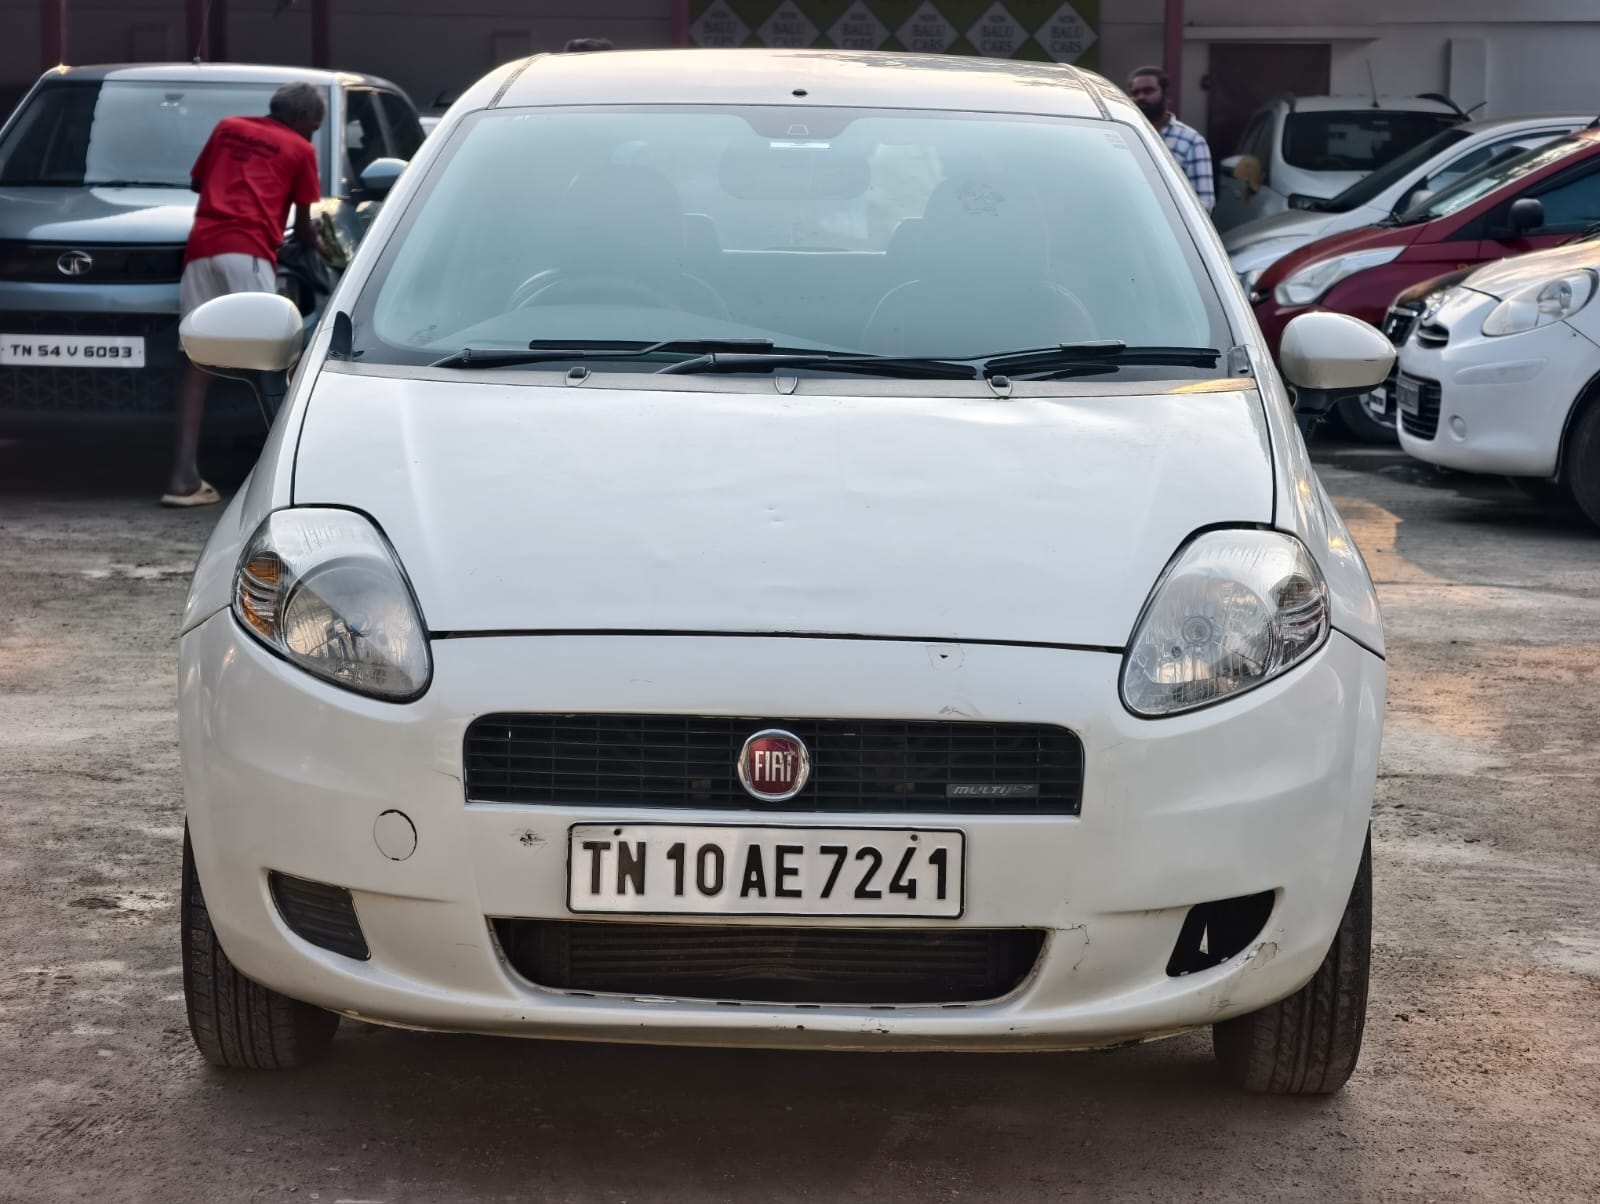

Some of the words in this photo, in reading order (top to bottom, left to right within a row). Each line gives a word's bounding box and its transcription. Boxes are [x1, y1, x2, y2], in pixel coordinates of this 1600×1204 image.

[11, 344, 32, 357] TN
[38, 345, 61, 357] 54
[67, 345, 78, 357] V
[83, 346, 132, 358] 6093
[755, 750, 796, 782] FIAT
[583, 841, 646, 896] TN
[666, 842, 725, 897] 10
[740, 844, 803, 898] AE
[819, 845, 947, 900] 7241
